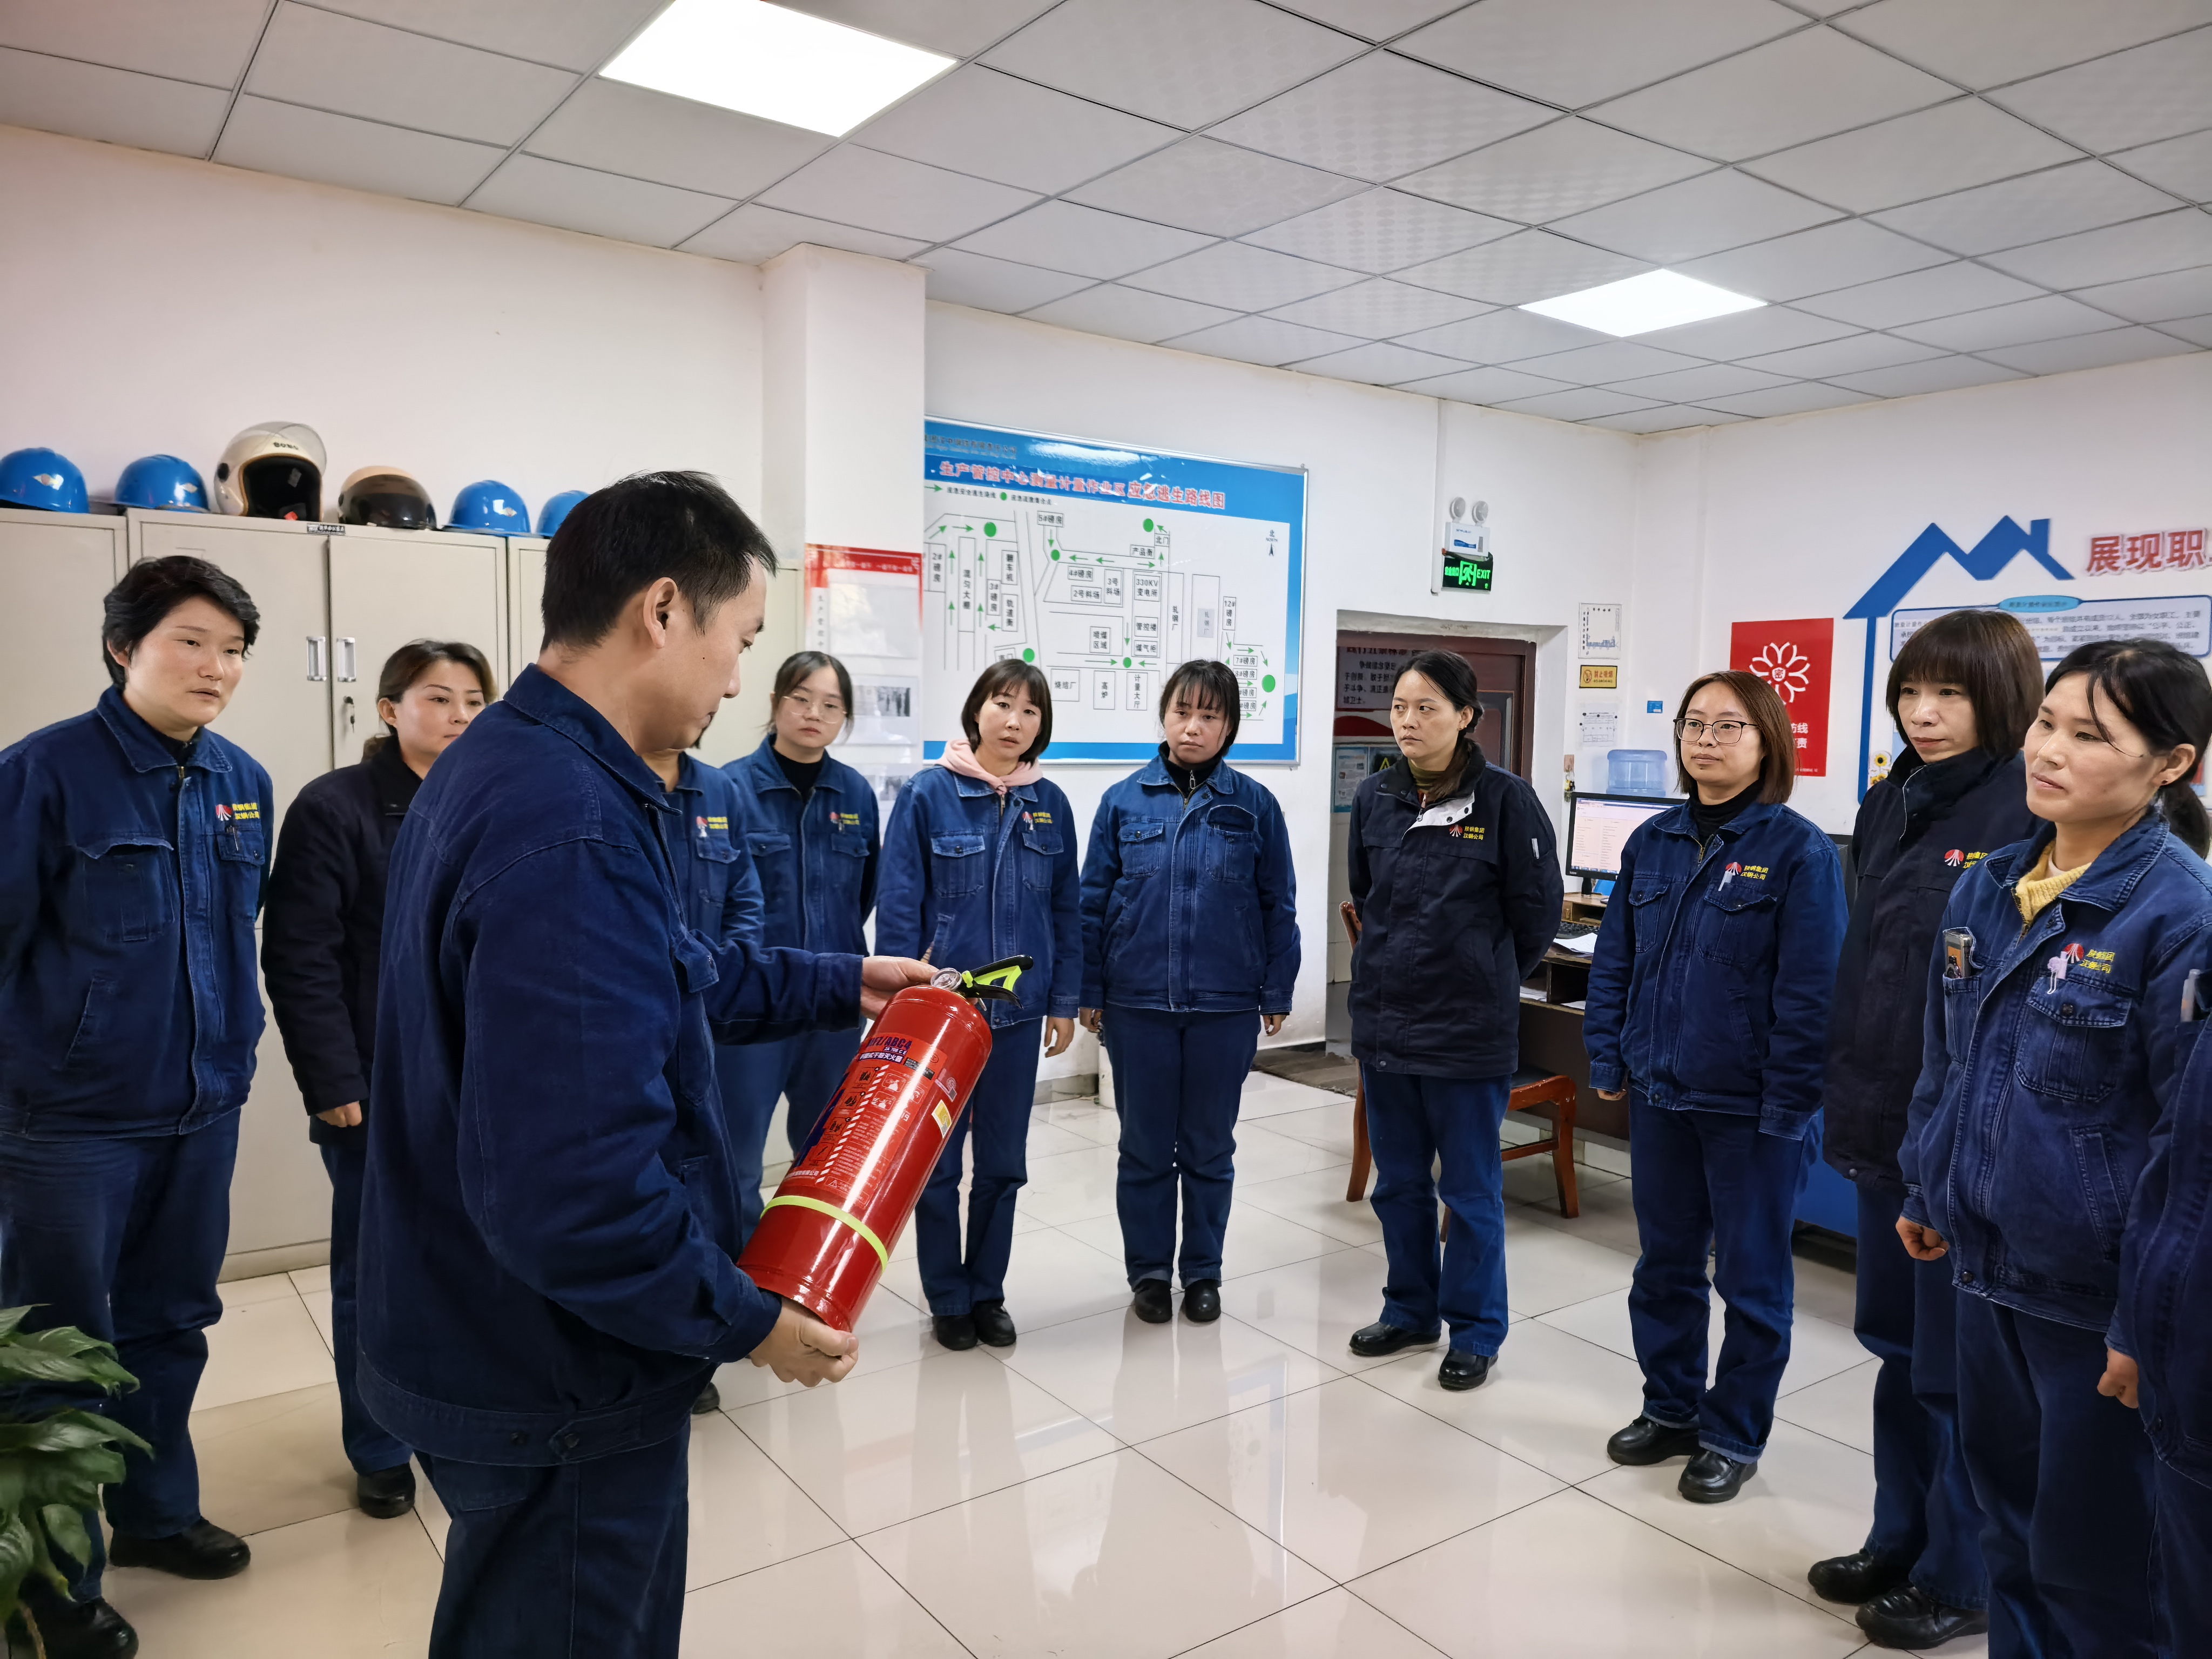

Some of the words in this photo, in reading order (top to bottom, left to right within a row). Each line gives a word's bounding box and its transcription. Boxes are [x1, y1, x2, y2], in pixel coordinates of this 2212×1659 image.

[1127, 480, 1225, 510] 应急逃生路线图
[1155, 535, 1169, 544] 北门
[1132, 547, 1153, 556] 产品衡
[2086, 530, 2204, 572] 展现职
[1476, 569, 1491, 579] EXIT
[1136, 578, 1158, 586] 330KV
[1073, 590, 1100, 599] 2号料场
[1105, 588, 1120, 596] 料场
[1137, 588, 1158, 597] 变电所
[1224, 600, 1235, 626] 12#磅房
[1136, 622, 1157, 632] 管控楼
[1093, 641, 1108, 649] 区域
[1236, 657, 1256, 665] 7#磅房
[1054, 681, 1076, 690] 烧结厂
[1101, 682, 1108, 698] 高炉
[1239, 689, 1255, 697] #磅房
[1240, 701, 1256, 710] #磅房
